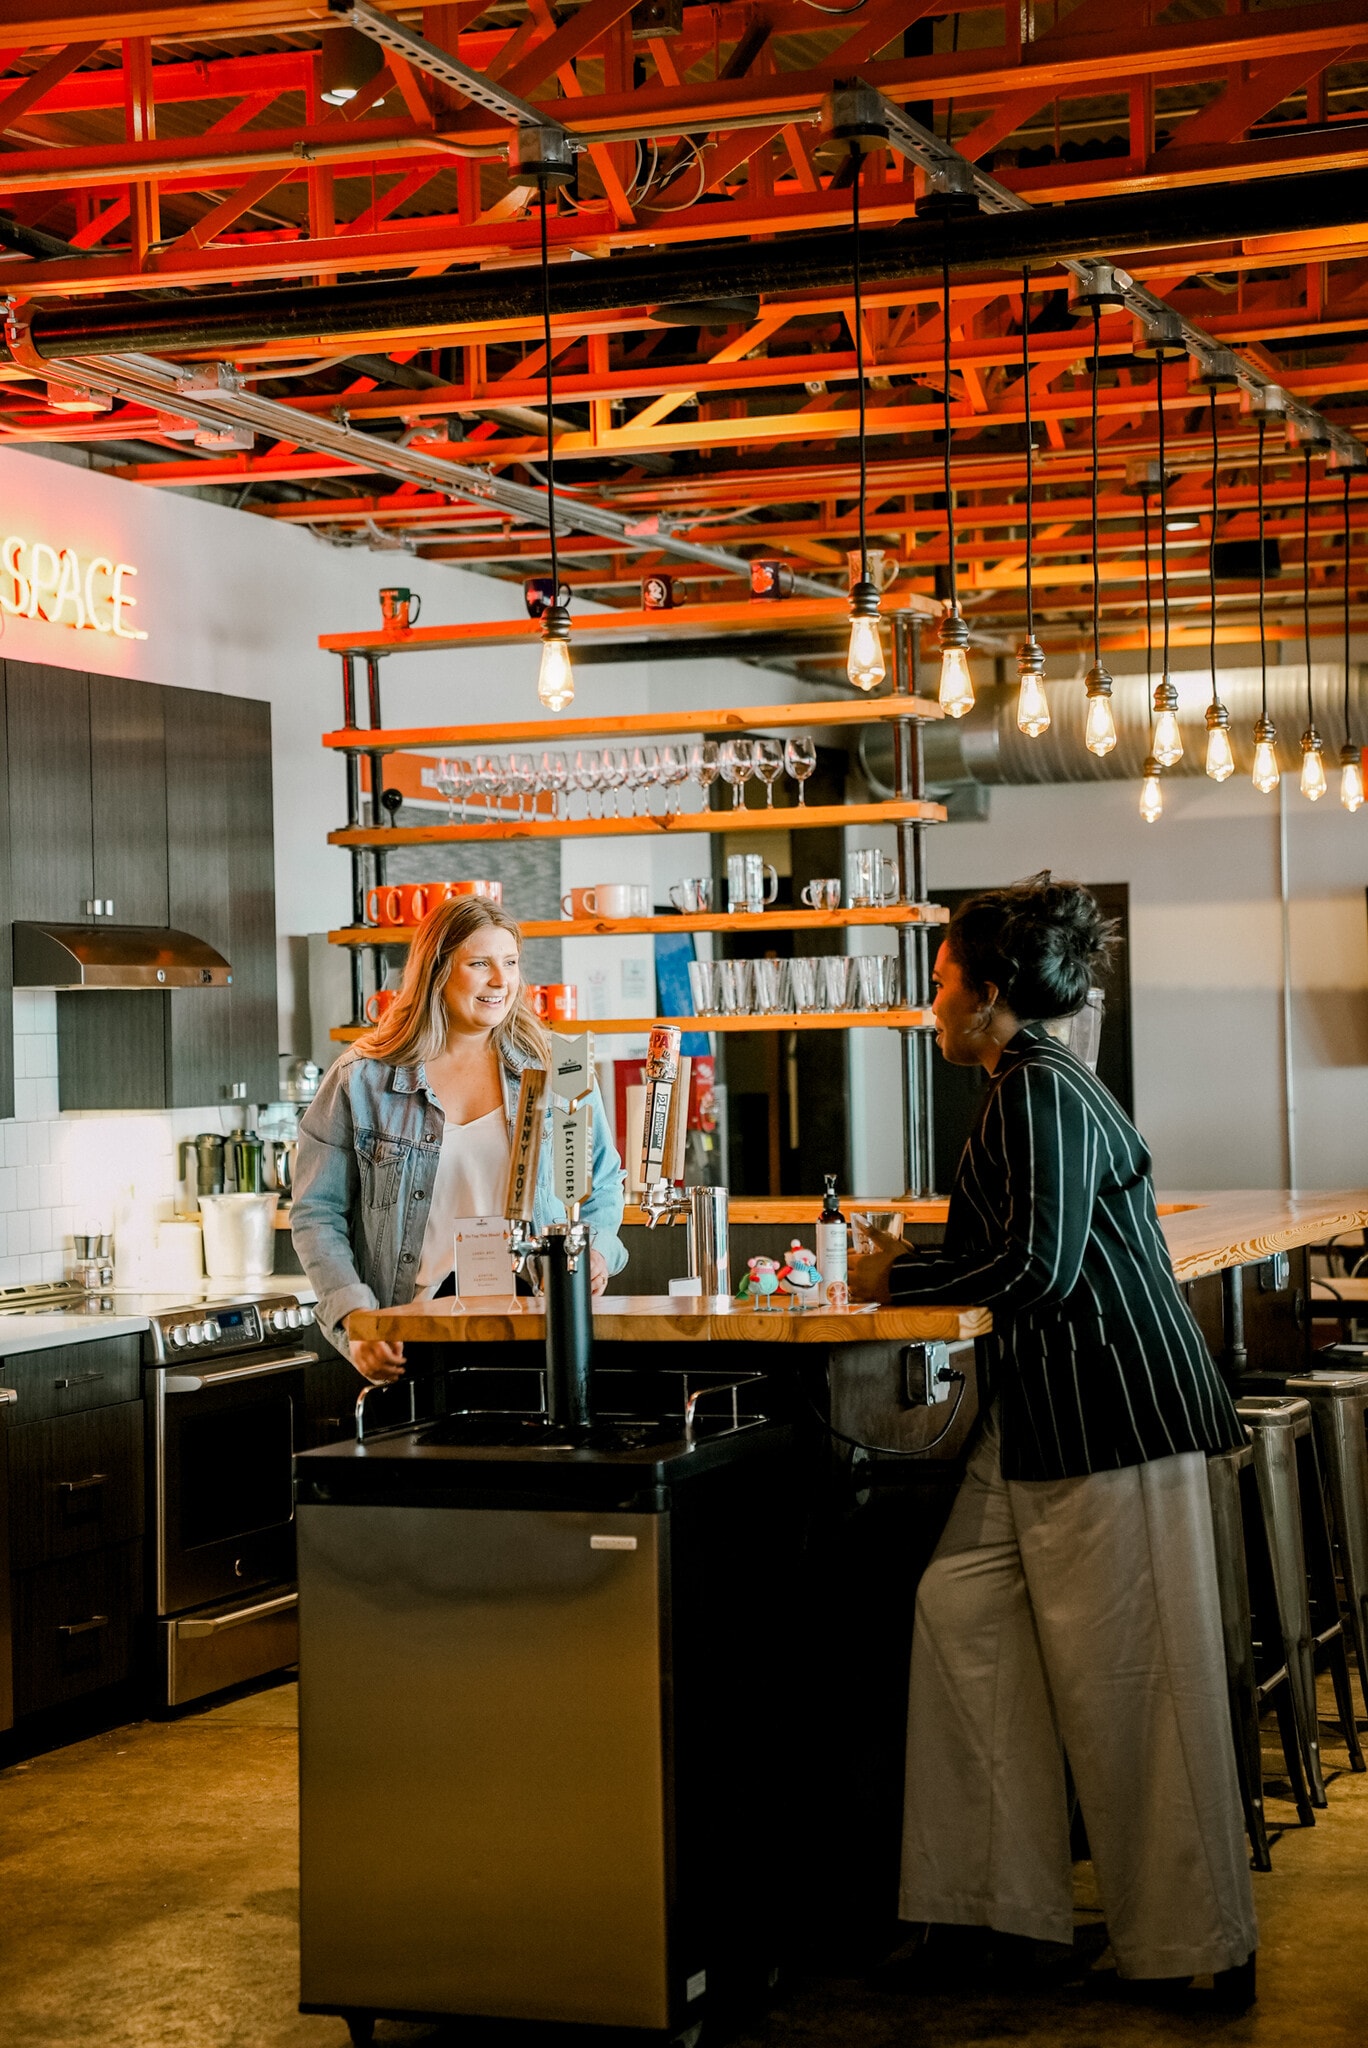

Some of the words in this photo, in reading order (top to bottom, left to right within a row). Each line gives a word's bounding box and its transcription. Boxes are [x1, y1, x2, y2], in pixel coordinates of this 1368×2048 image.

[0, 536, 148, 640] SPACE
[520, 1087, 534, 1155] LENNY
[657, 1113, 665, 1149] AMENDMENT
[514, 1164, 525, 1202] BOY
[565, 1131, 575, 1199] EASTCIDERS
